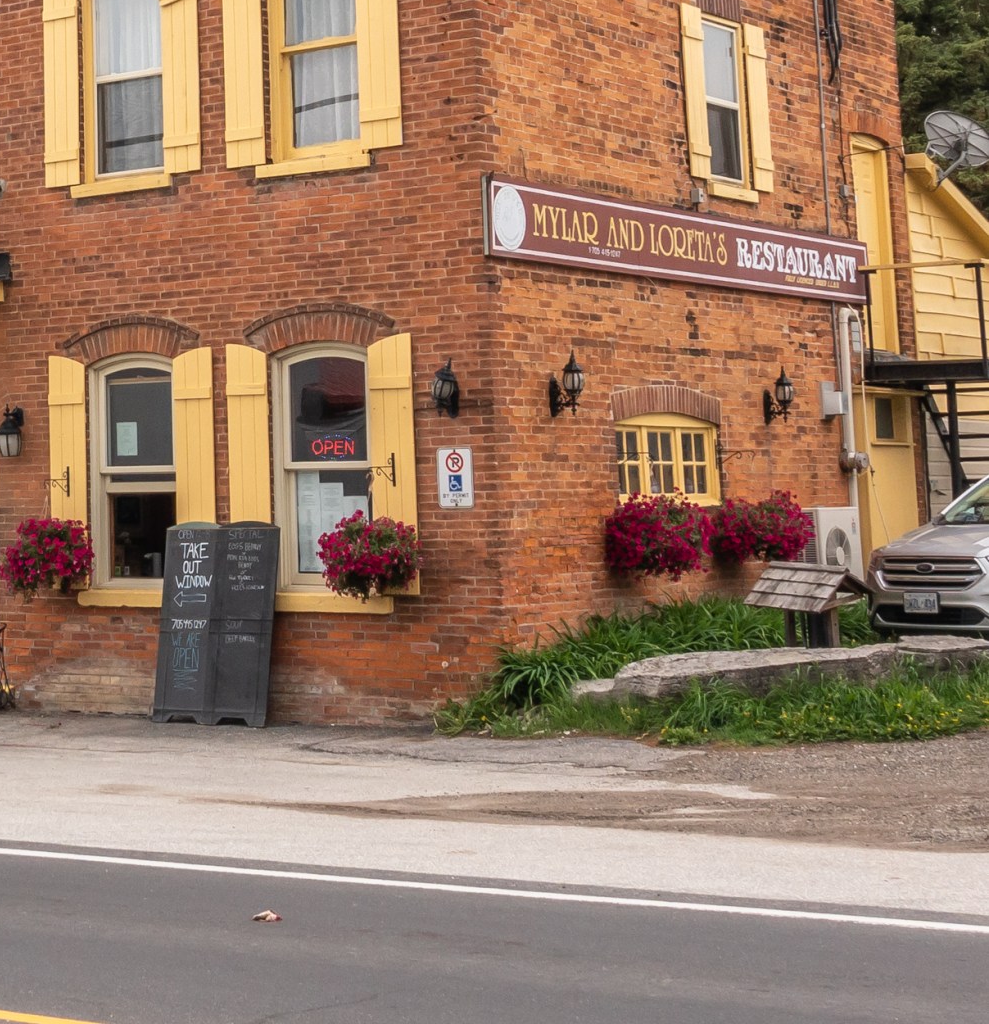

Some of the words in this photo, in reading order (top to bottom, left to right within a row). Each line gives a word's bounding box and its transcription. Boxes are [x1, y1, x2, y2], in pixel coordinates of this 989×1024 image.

[532, 203, 599, 246] MYLAR
[606, 217, 644, 251] AND
[648, 223, 728, 266] LORETA'S
[735, 238, 857, 283] RESTAURANT
[311, 439, 355, 455] OPEN
[179, 542, 209, 559] TAKE
[182, 560, 202, 574] OUT
[175, 574, 213, 589] WINDOW
[173, 647, 199, 669] OPEN
